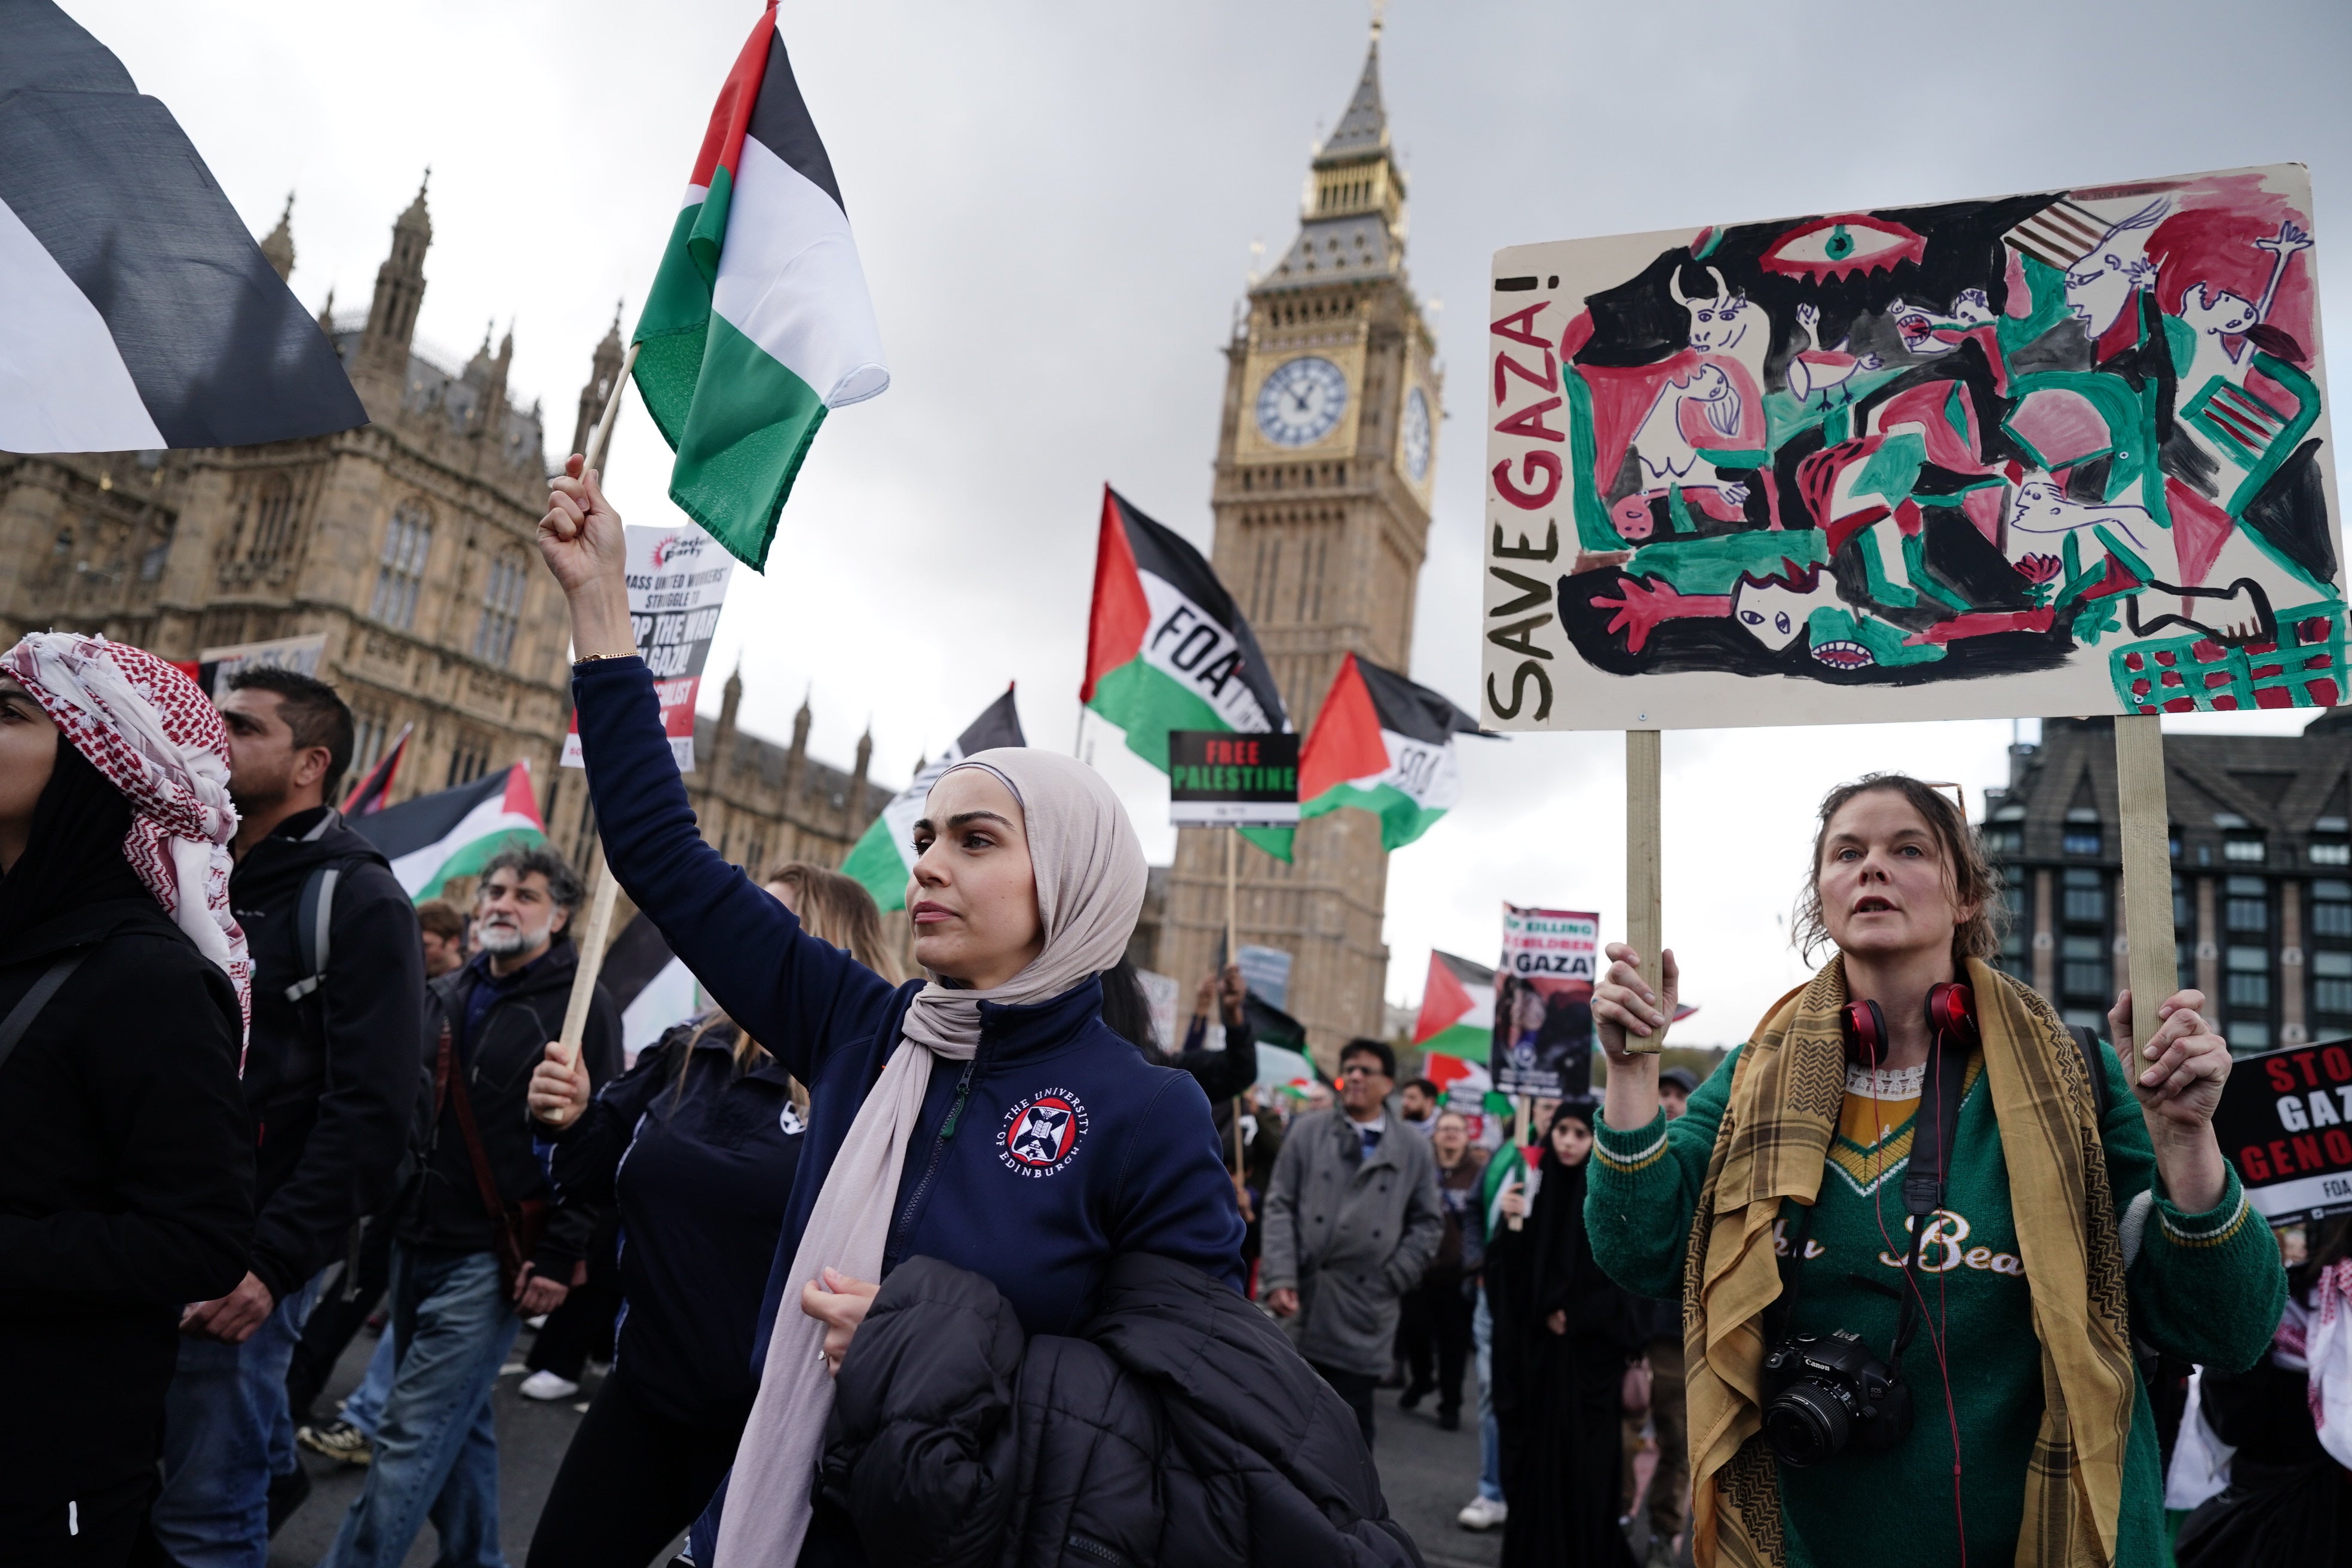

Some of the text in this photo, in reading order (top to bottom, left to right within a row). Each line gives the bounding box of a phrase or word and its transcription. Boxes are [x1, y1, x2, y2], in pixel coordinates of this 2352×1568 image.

[1487, 275, 1565, 722] SAVE GAZA!
[652, 613, 687, 646] THE
[682, 608, 719, 644] WAR
[647, 643, 693, 677] GAZA!
[1151, 605, 1242, 698] FOA
[1205, 740, 1260, 766] FREE
[1172, 765, 1296, 791] PALESTINE
[1516, 953, 1589, 974] GAZA
[1004, 1087, 1089, 1135] THE UNIVERSITY
[996, 1131, 1080, 1178] OF EDINBURGH
[2322, 1178, 2352, 1198] FOA
[1805, 1358, 1830, 1371] Canon
